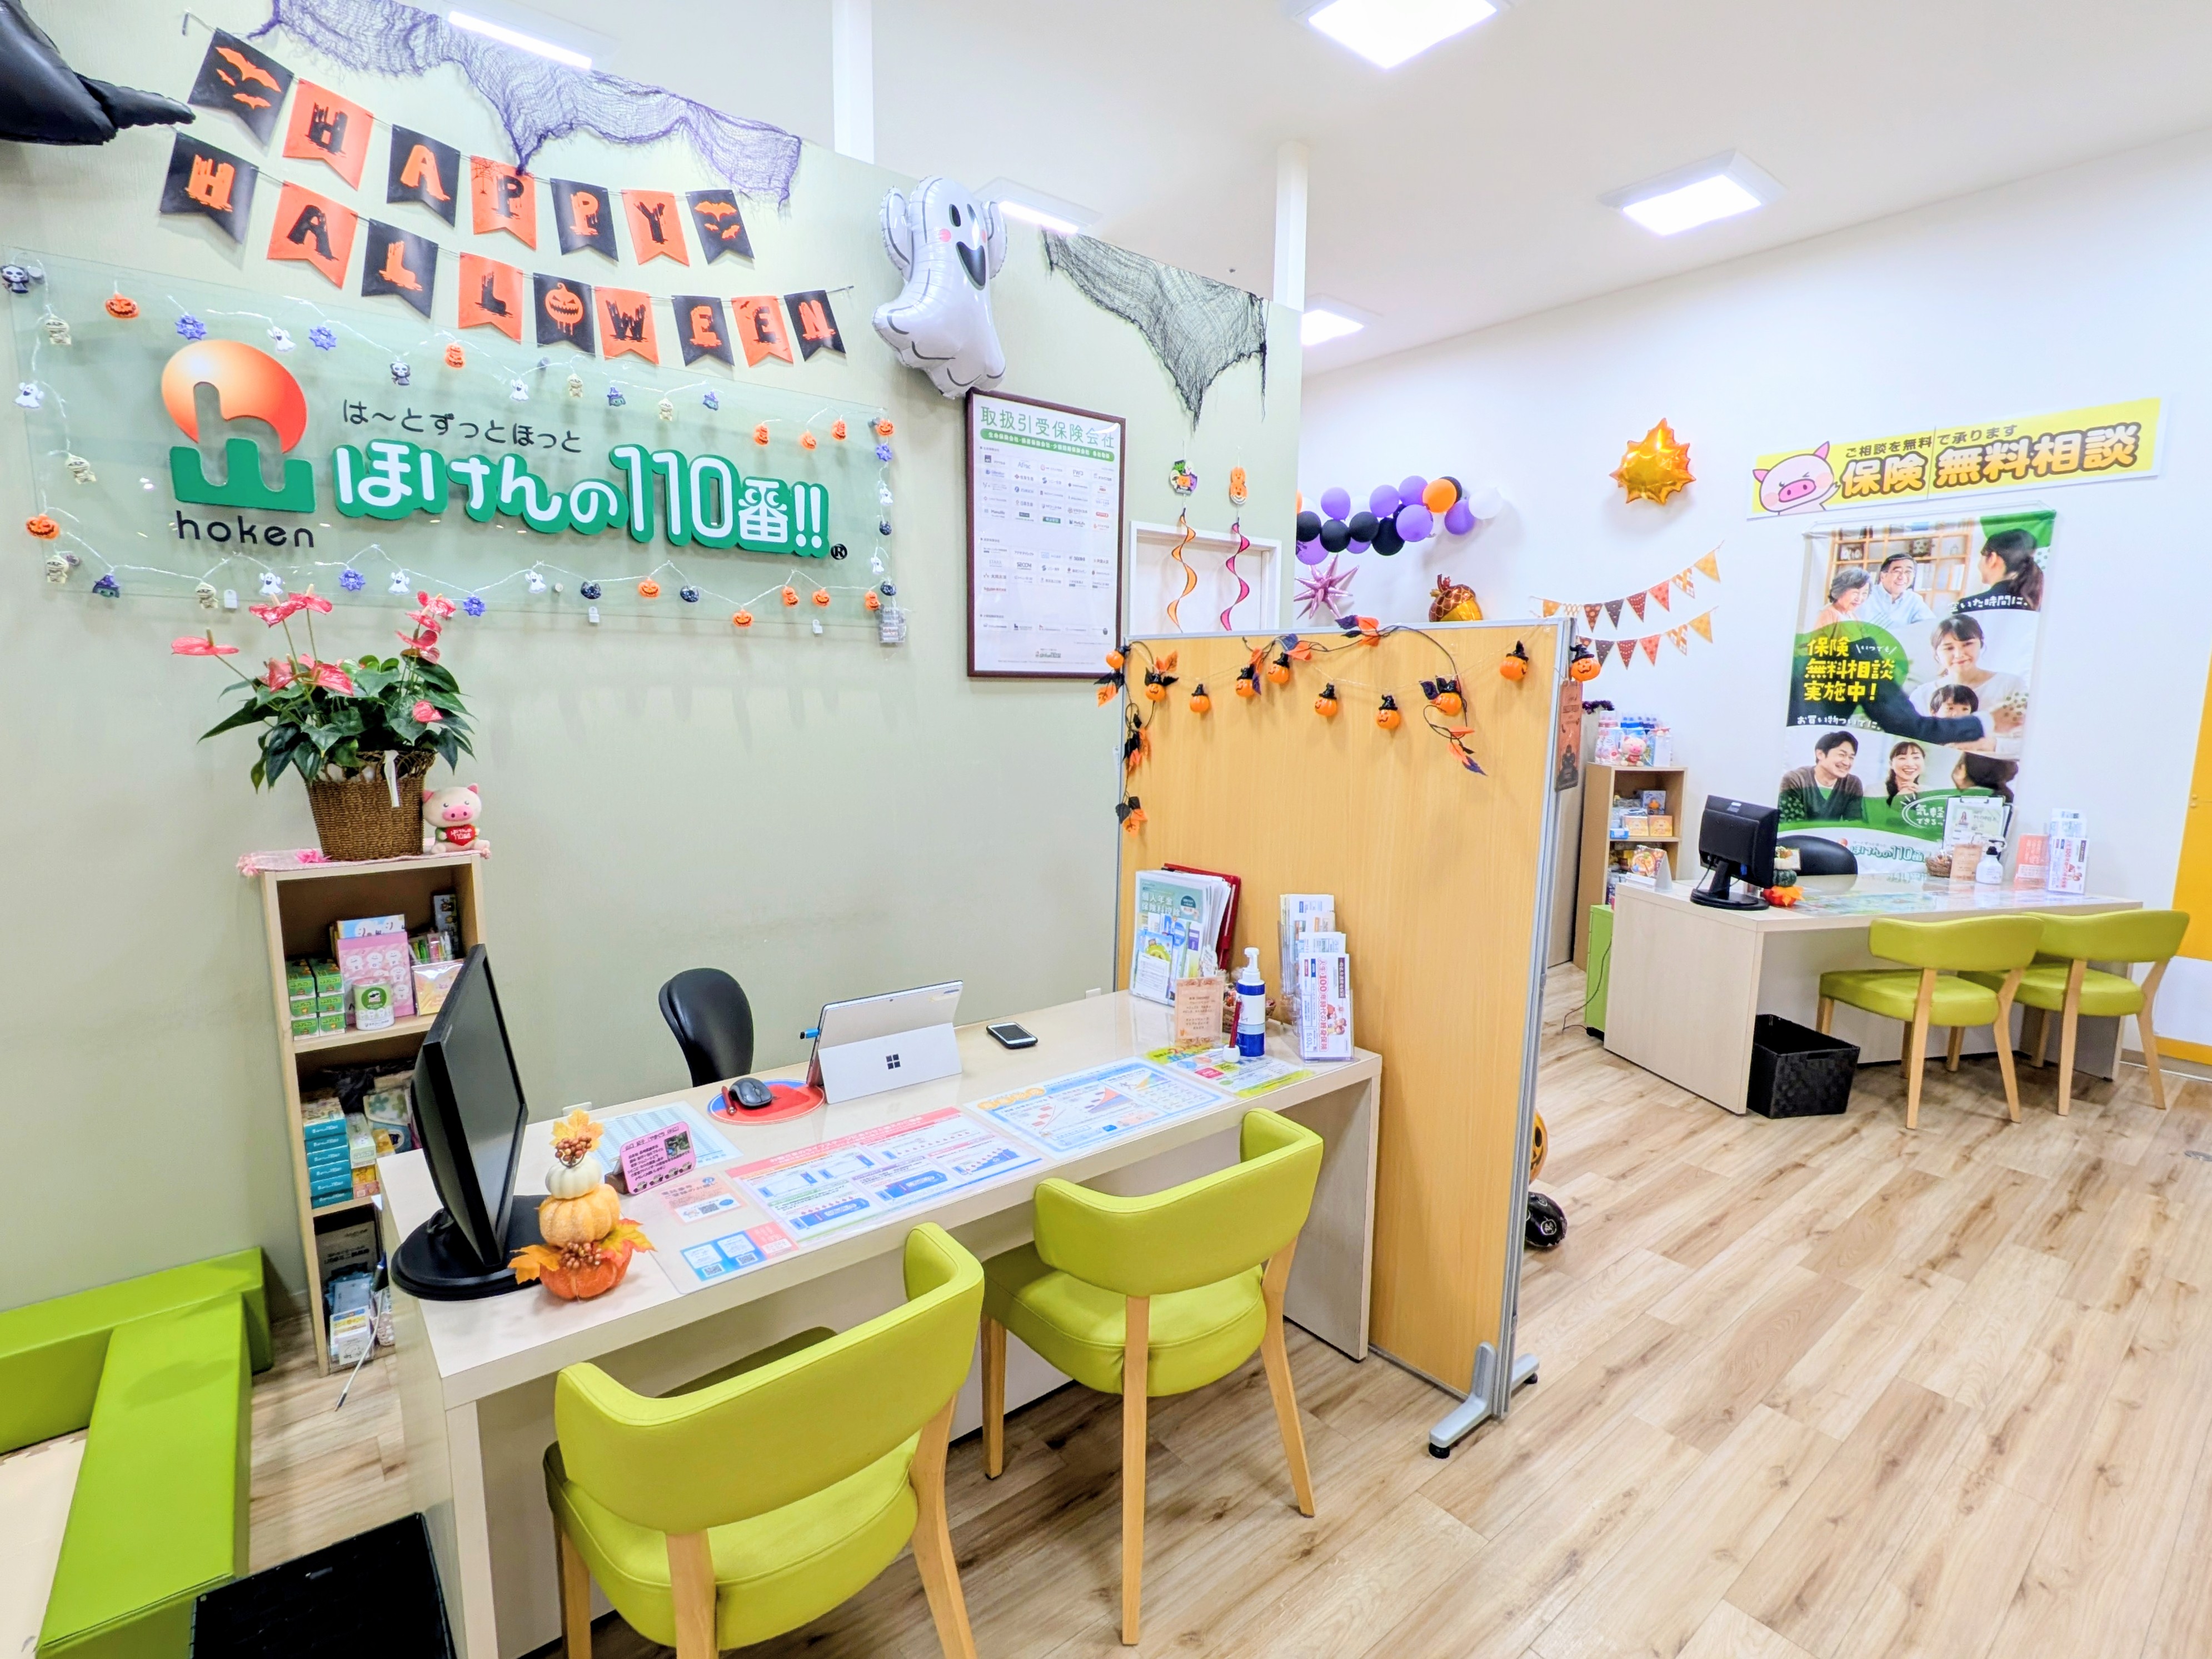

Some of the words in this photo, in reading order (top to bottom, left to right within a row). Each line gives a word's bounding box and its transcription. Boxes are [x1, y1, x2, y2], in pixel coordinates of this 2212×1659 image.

[306, 102, 667, 244] HAPPY
[981, 406, 1114, 449] 取扱引受保険会社
[1845, 424, 2018, 458] ご相談を無料で承ります
[1840, 457, 1927, 498] 保険
[1935, 422, 2141, 489] 無料相談
[177, 509, 316, 549] hoken
[1807, 636, 1850, 657] 保険
[1804, 658, 1895, 681] 無料相談
[1804, 679, 1878, 702] 実施中!
